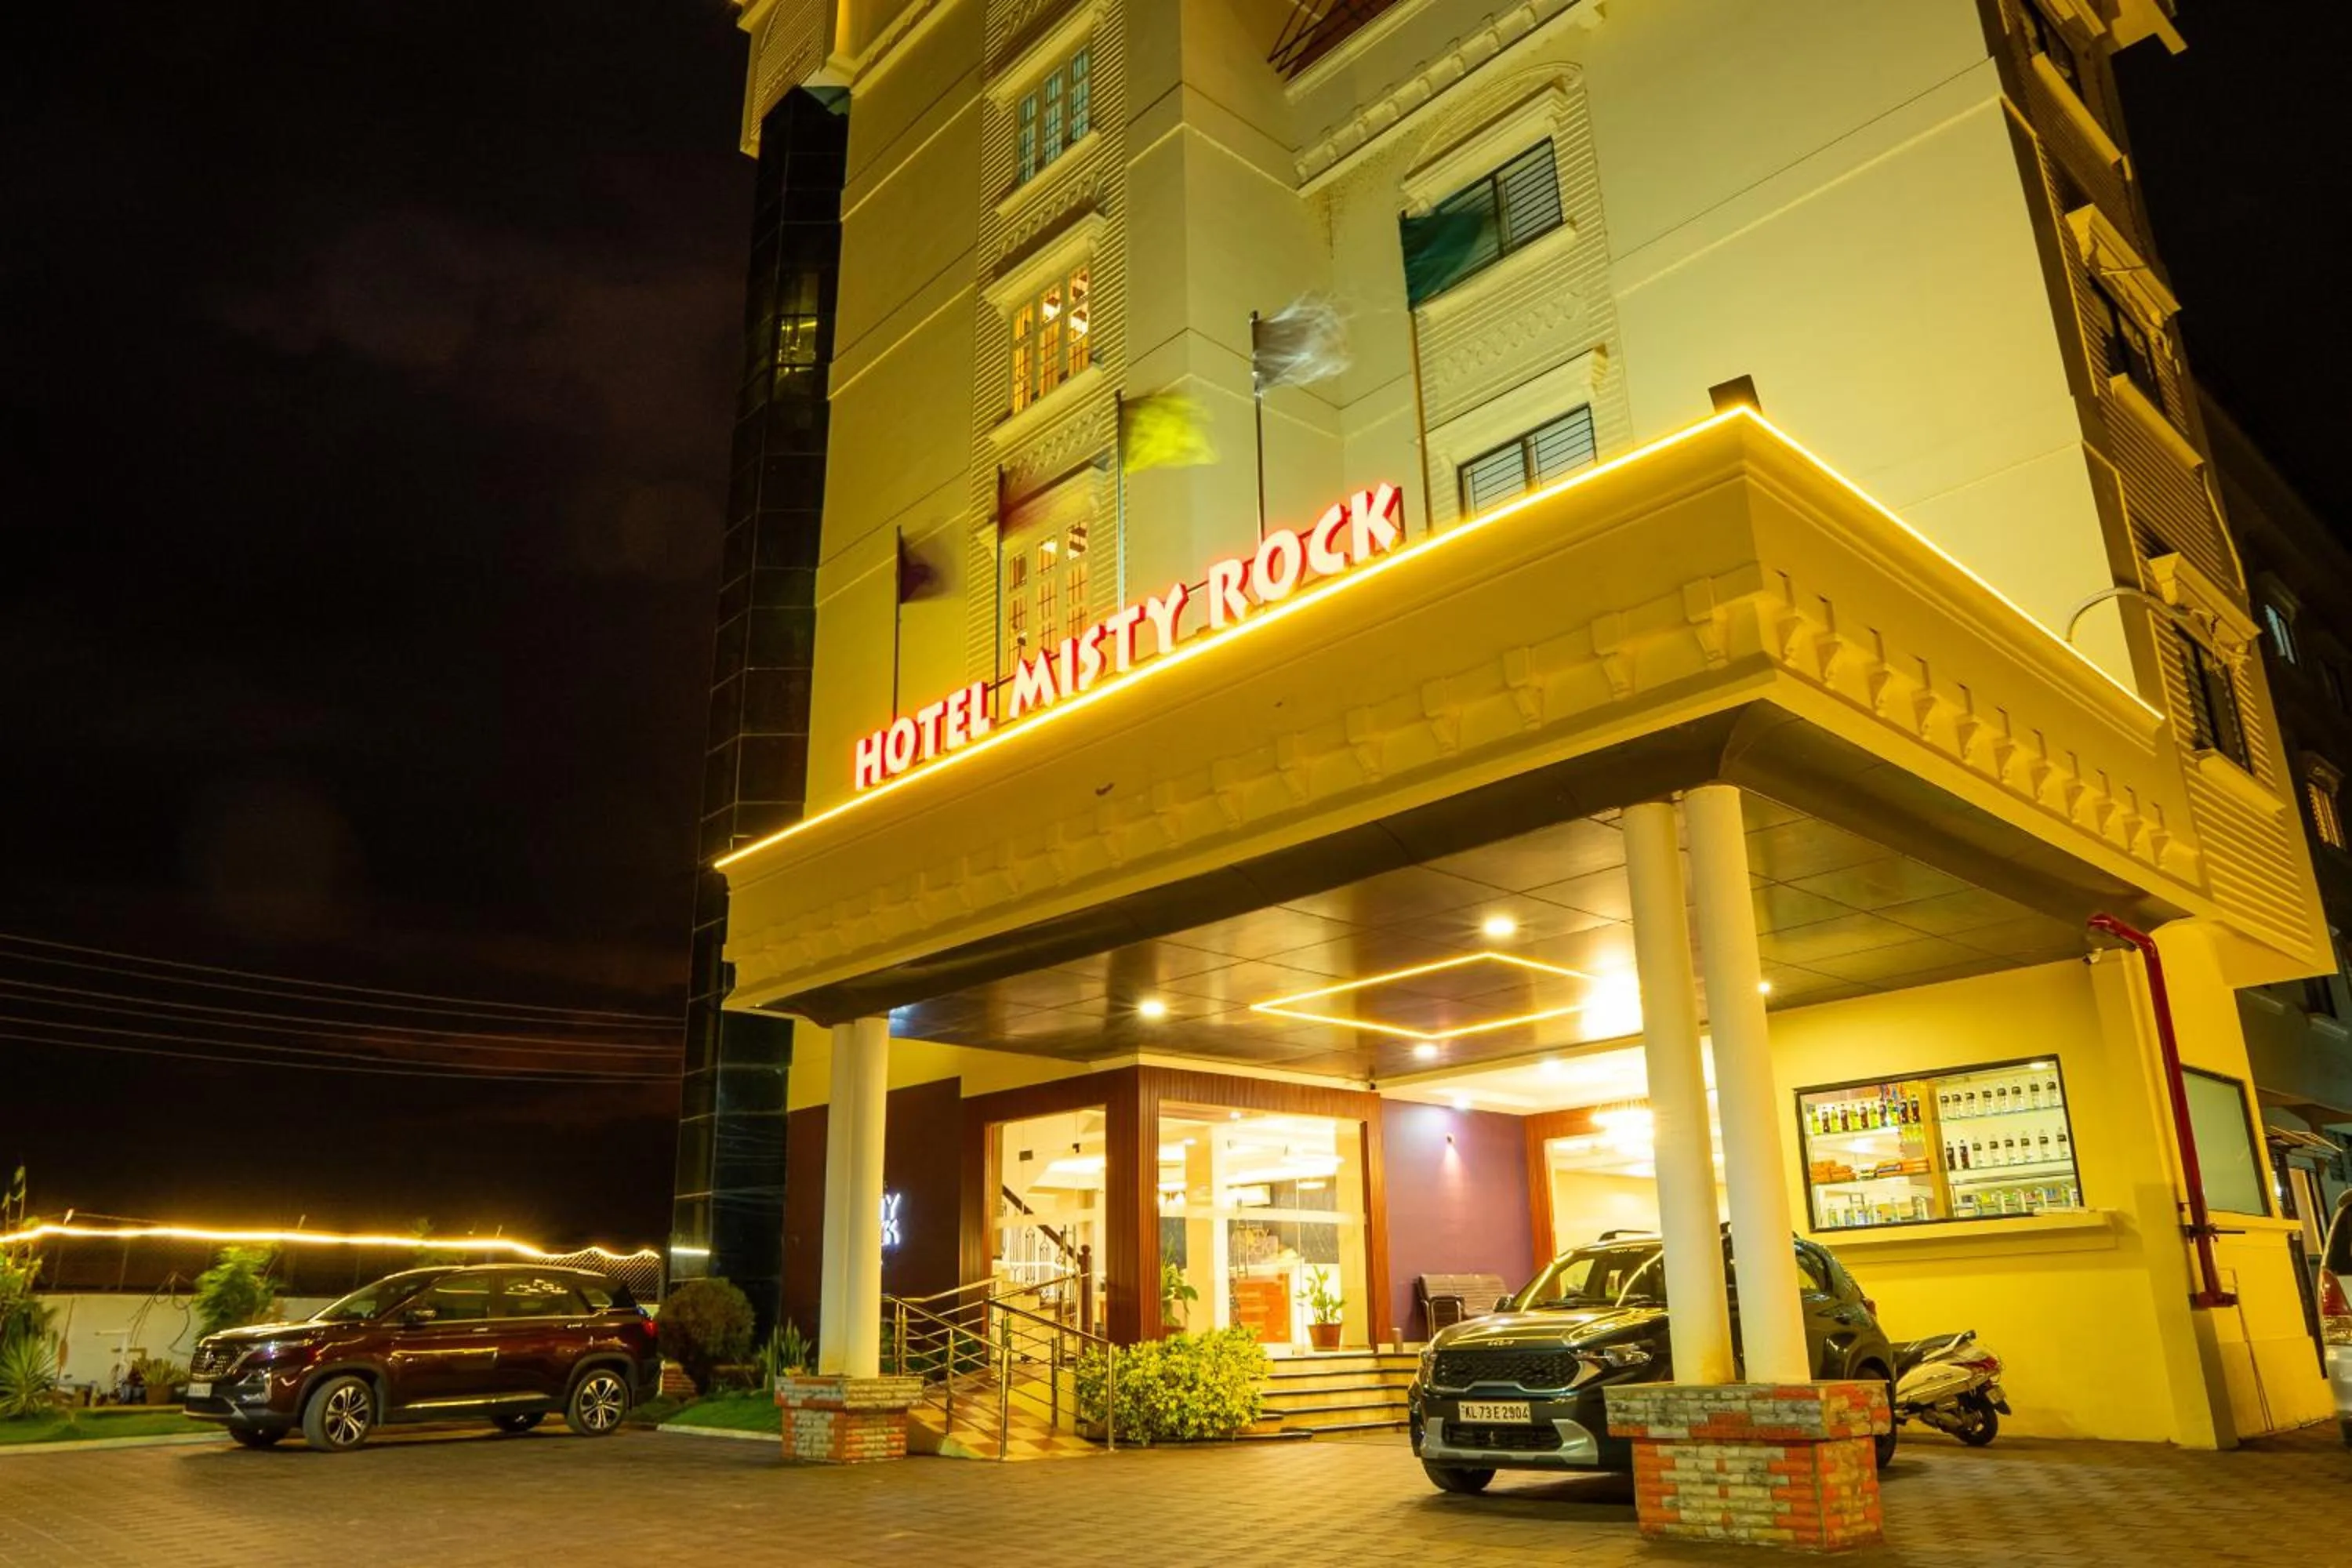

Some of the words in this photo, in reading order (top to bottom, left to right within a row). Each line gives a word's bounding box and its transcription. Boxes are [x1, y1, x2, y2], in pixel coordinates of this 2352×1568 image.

[855, 681, 991, 792] HOTEL
[1008, 582, 1188, 719] MISTY
[1208, 481, 1401, 631] ROCK
